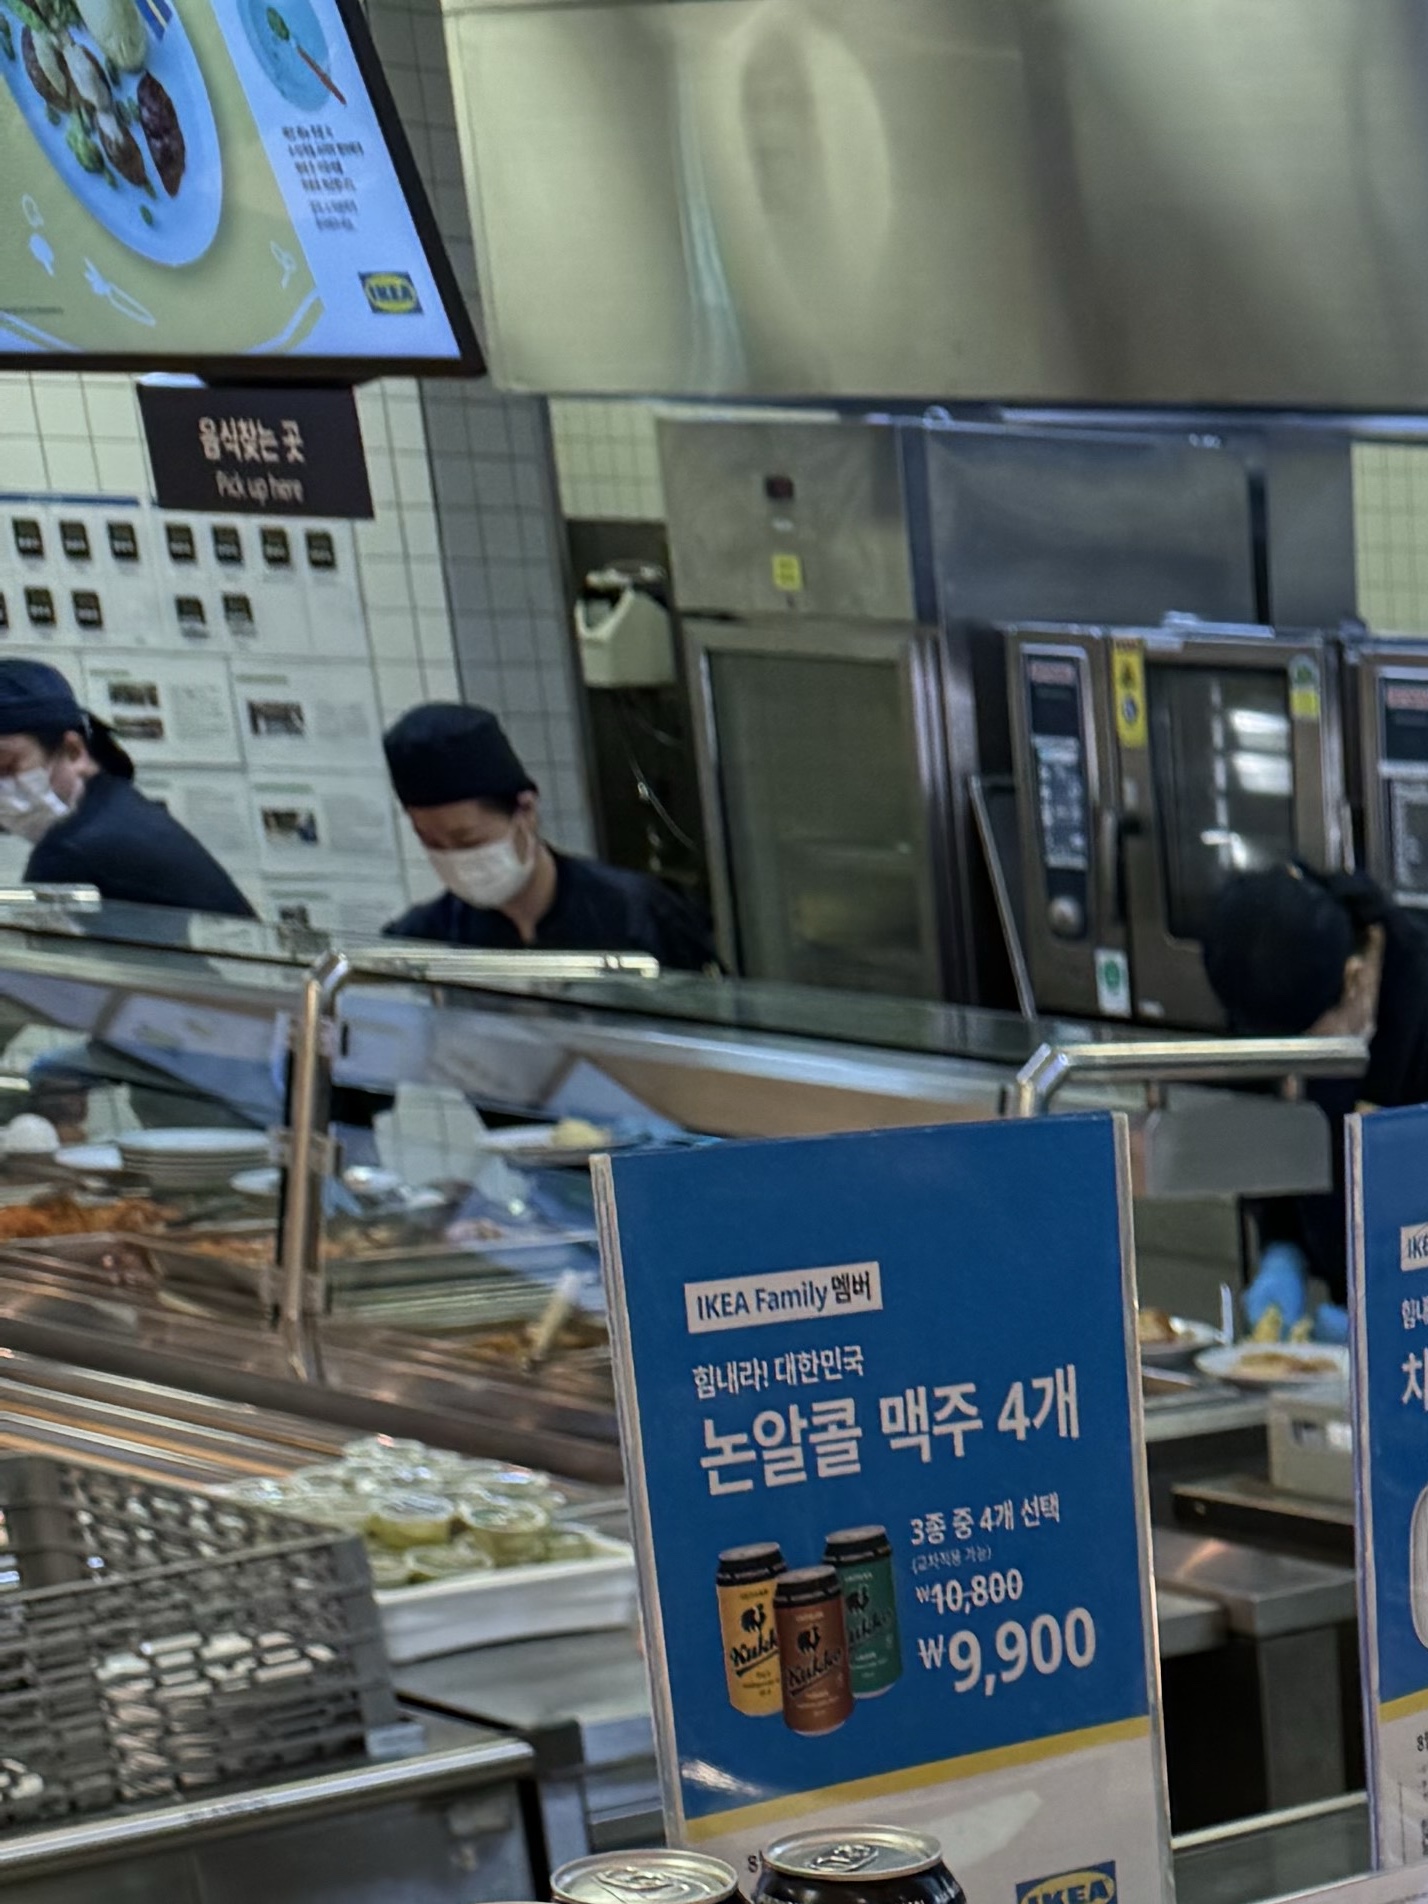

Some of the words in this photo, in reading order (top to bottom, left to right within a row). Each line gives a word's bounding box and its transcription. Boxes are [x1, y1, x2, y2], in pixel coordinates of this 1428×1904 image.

[199, 416, 280, 462] 음식찾는
[280, 419, 306, 463] 곳
[215, 469, 248, 498] Pick
[267, 471, 304, 503] here
[697, 1291, 750, 1321] IKEA
[755, 1280, 828, 1313] Family
[830, 1270, 872, 1304] 멤버
[692, 1356, 770, 1400] 힘내라!
[773, 1344, 865, 1386] 대한민국
[699, 1398, 863, 1496] 논알콜
[879, 1382, 983, 1463] 맥주
[997, 1363, 1080, 1441] 4개
[910, 1511, 947, 1546] 3종
[952, 1506, 975, 1540] 중
[979, 1498, 1015, 1532] 4개
[1020, 1491, 1061, 1528] 선택
[915, 1567, 1024, 1615] ₩10,800
[917, 1606, 1096, 1697] ₩9,900
